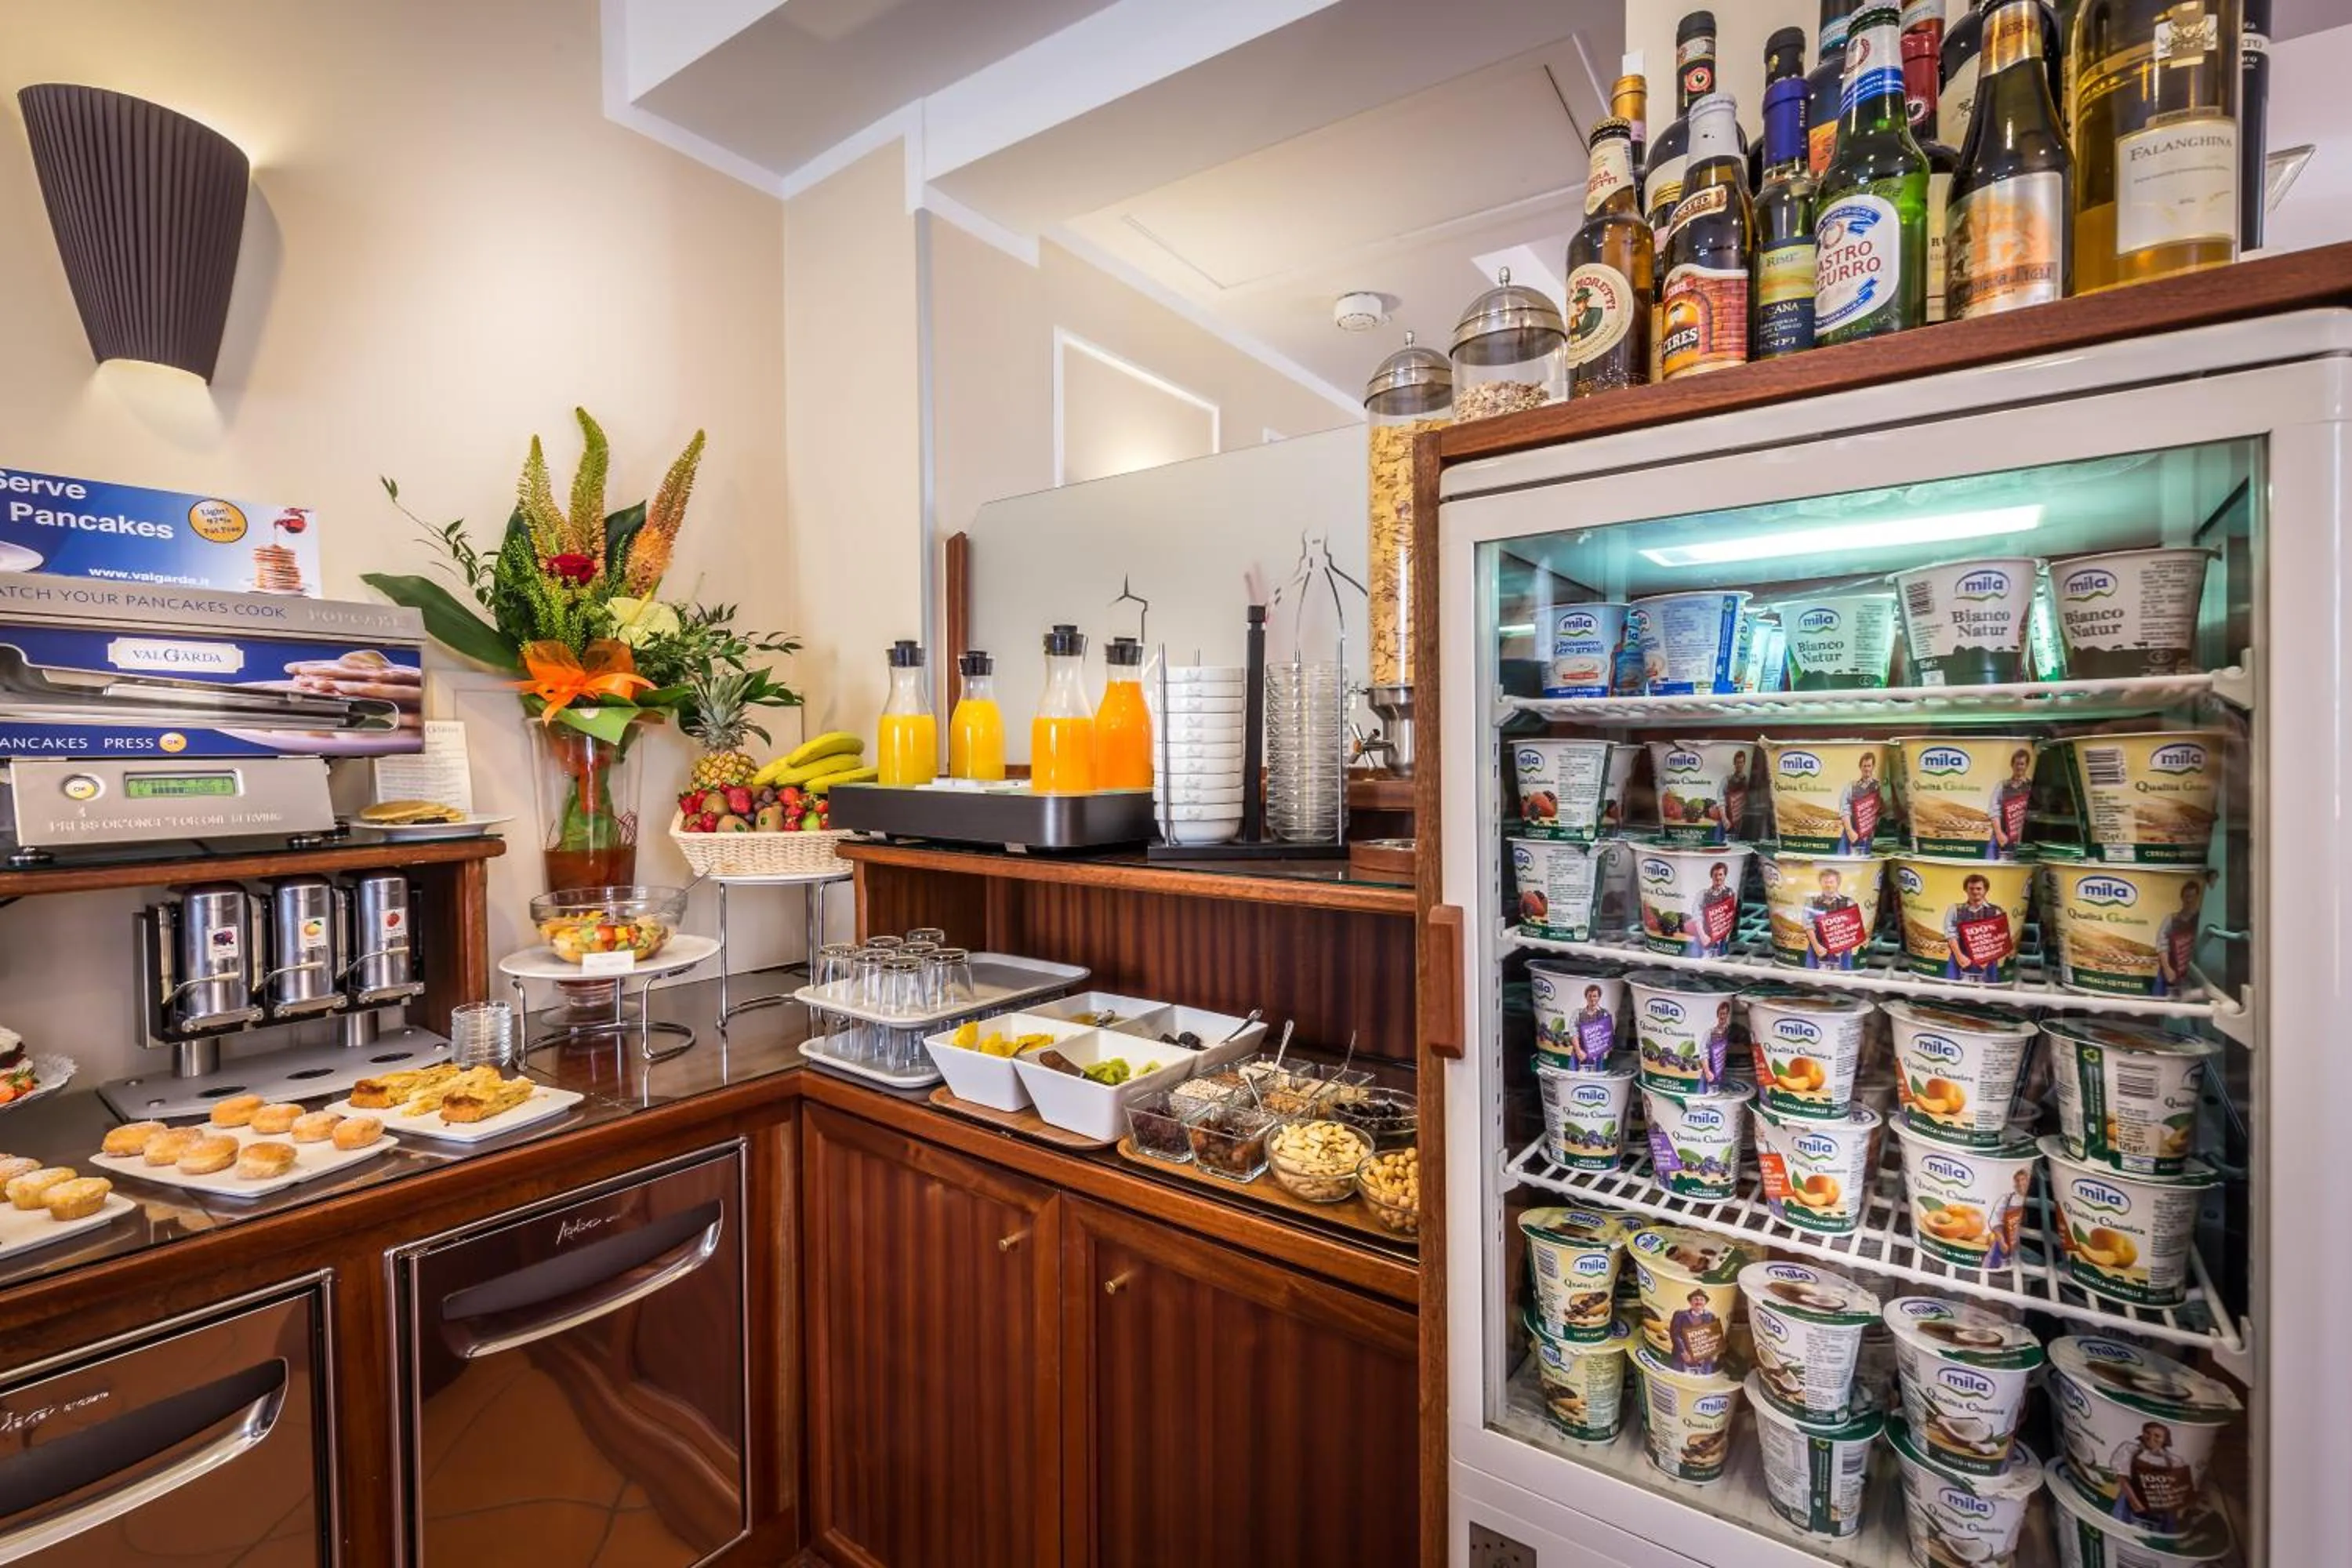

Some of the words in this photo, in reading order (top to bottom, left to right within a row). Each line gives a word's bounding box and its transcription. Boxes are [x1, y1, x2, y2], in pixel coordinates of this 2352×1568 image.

[2129, 136, 2232, 162] FALANGHINA
[1819, 241, 1872, 272] ASTRO
[1816, 257, 1881, 295] ZZURRO
[1575, 276, 1616, 310] MORETTI
[10, 502, 174, 539] Pancakes
[88, 568, 210, 586] www.valgarda.it
[1965, 577, 2004, 592] mila
[2070, 576, 2108, 593] mila
[60, 590, 118, 605] YOUR
[125, 595, 228, 615] PANCAKES
[234, 604, 286, 618] COOK
[1564, 617, 1592, 628] mila
[1803, 614, 1834, 626] mila
[1951, 610, 2010, 624] Bianco
[2064, 608, 2124, 624] Bianco
[1958, 626, 2008, 638] Natur
[2070, 623, 2122, 638] Natur
[1798, 640, 1844, 652] Bianco
[1802, 652, 1842, 663] Natur
[104, 737, 154, 749] PRESS
[1669, 753, 1697, 766] mila
[1783, 757, 1815, 769] mila
[1924, 753, 1962, 767] mila
[2161, 750, 2201, 765] mila
[1644, 866, 1669, 877] mila
[2084, 883, 2128, 898] mila
[1650, 1003, 1679, 1017] mila
[1780, 1023, 1815, 1037] mila
[1918, 1040, 1955, 1056] mila
[1577, 1090, 1605, 1101] mila
[1688, 1112, 1720, 1123] mila
[1798, 1139, 1833, 1152] mila
[1928, 1161, 1966, 1180] mila
[2078, 1184, 2122, 1205] mila
[1579, 1259, 1606, 1271] mila
[1774, 1269, 1812, 1283] mila
[1908, 1305, 1945, 1315] mila
[2087, 1344, 2132, 1360] mila
[1947, 1374, 1988, 1392] mila
[1700, 1401, 1728, 1412] mila
[1947, 1492, 1988, 1512] mila
